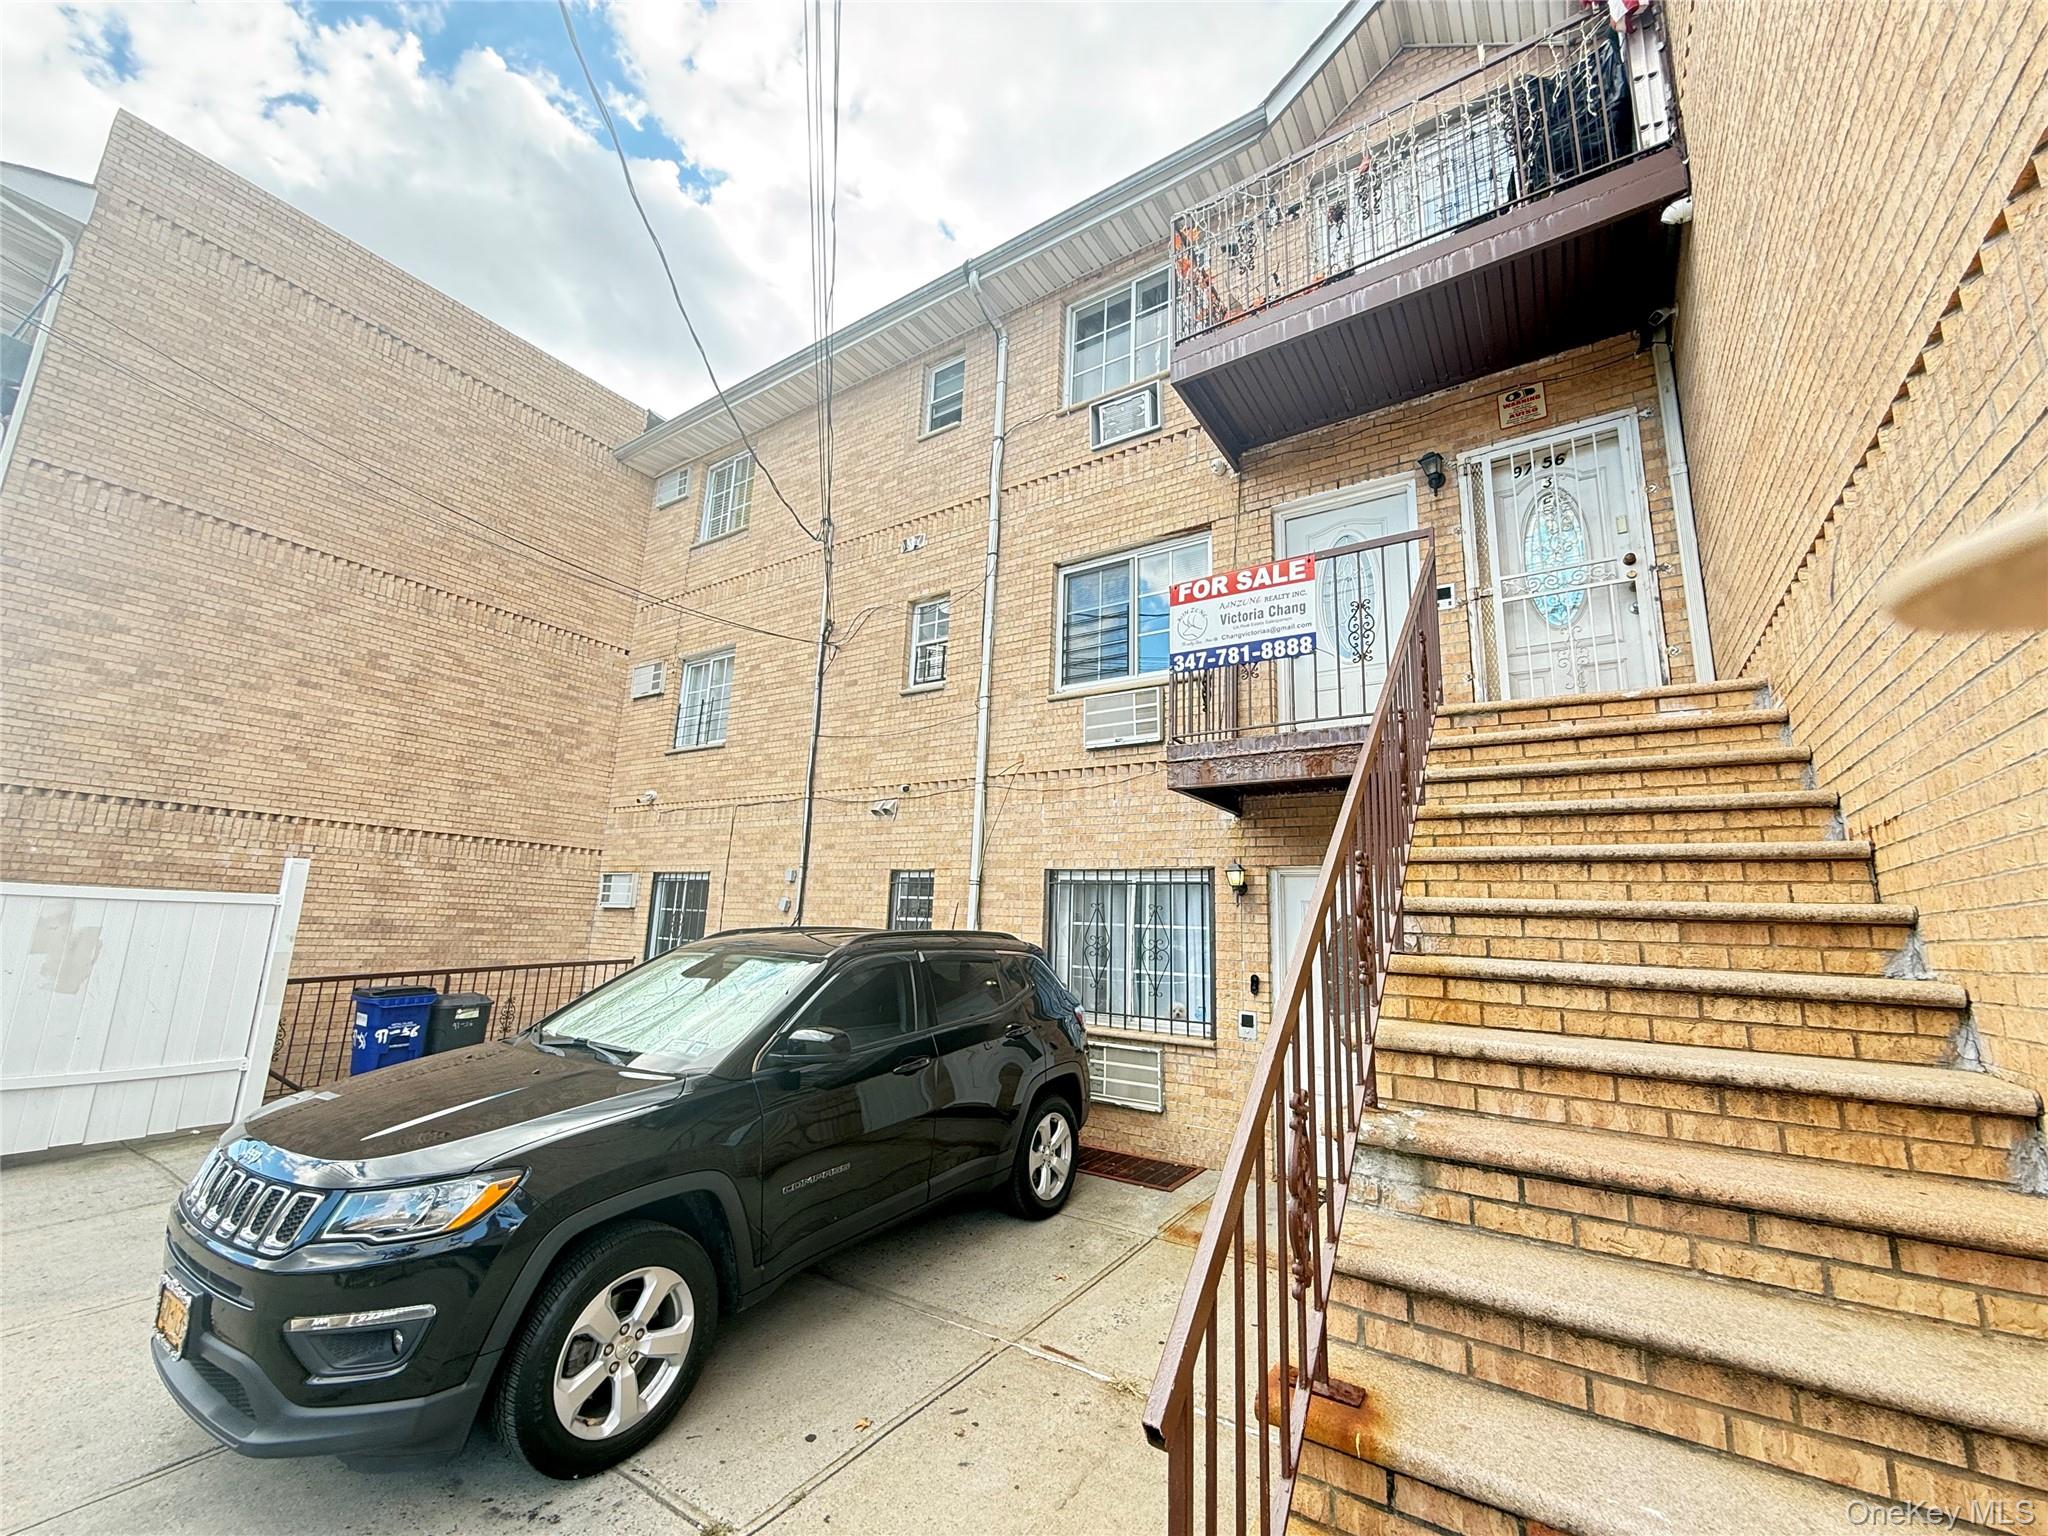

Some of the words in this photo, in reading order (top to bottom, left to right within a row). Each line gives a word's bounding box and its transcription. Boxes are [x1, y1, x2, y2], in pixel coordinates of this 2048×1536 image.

[1503, 394, 1541, 409] WARNING
[1509, 407, 1538, 419] AVISO
[1513, 460, 1535, 479] 97
[1542, 453, 1566, 469] 56
[1178, 575, 1229, 602] FOR
[1236, 559, 1307, 591] SALE
[1264, 593, 1290, 603] REALTY
[1220, 608, 1264, 625] Victoria
[1268, 602, 1306, 617] Chang
[1174, 635, 1313, 672] 347-781-8888
[375, 1025, 420, 1044] 97-56
[782, 1162, 851, 1195] COMPASS
